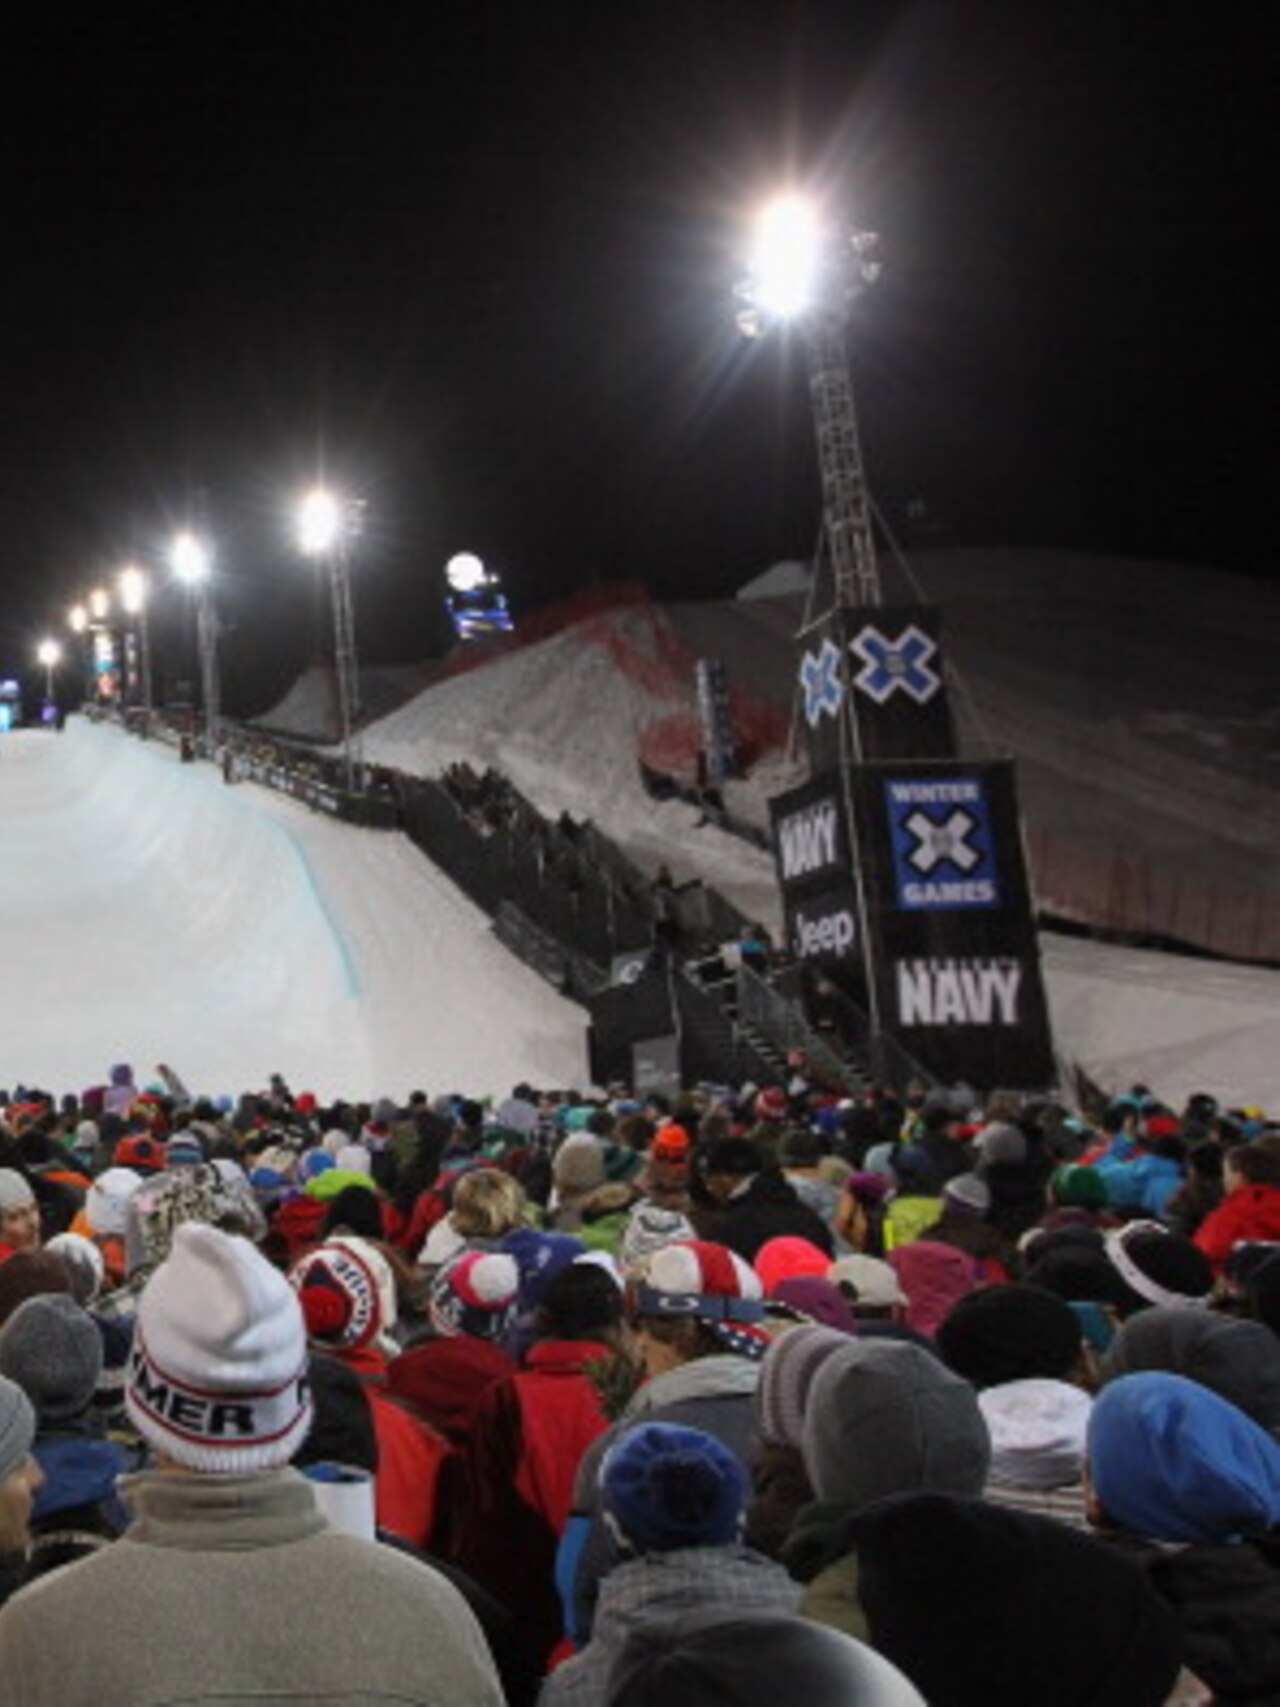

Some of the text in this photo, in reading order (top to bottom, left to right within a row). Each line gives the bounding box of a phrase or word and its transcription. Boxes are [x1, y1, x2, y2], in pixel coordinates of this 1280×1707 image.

[892, 783, 979, 801] WINTER
[780, 805, 837, 878] NAVY
[904, 880, 994, 902] GAMES
[794, 911, 854, 955] Jeep
[898, 959, 1019, 1025] NAVY
